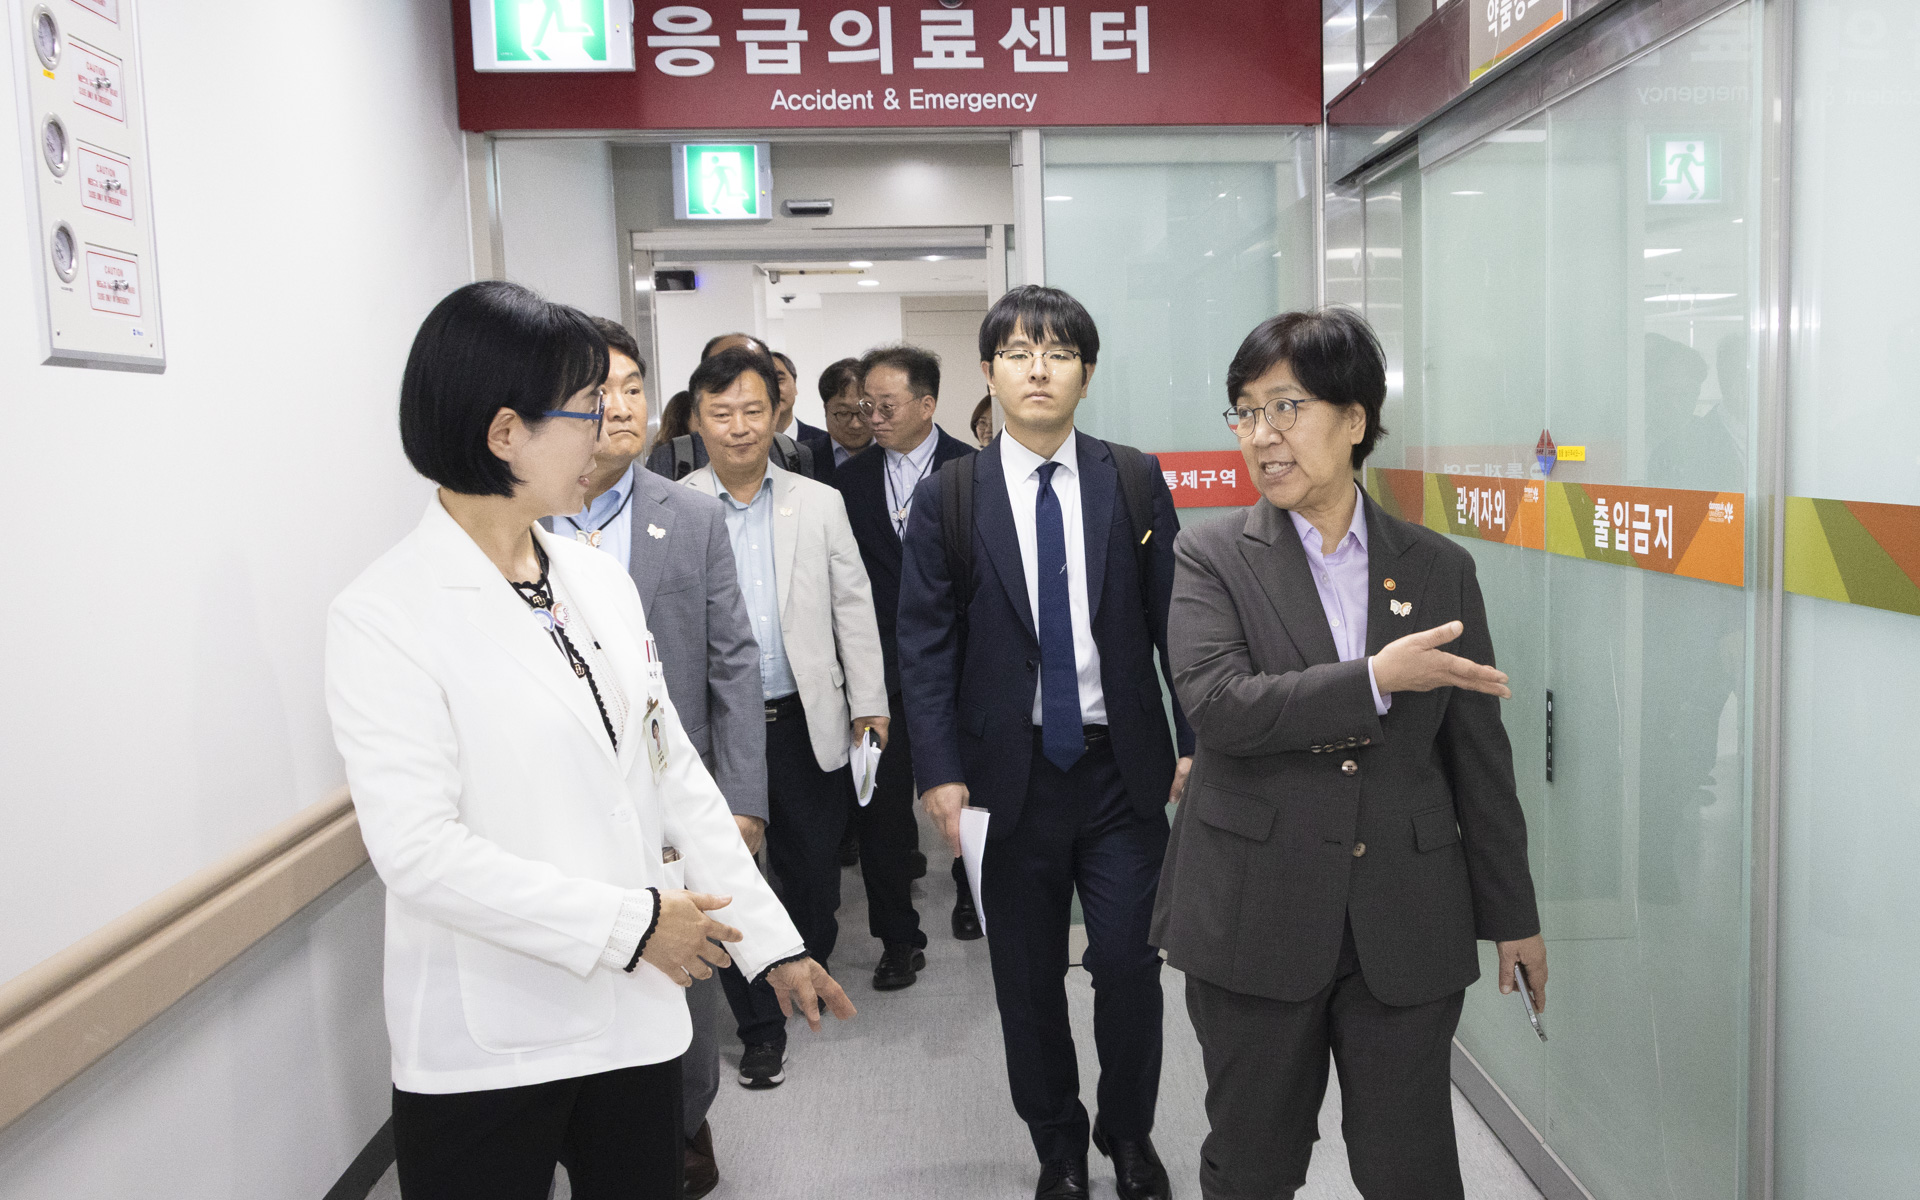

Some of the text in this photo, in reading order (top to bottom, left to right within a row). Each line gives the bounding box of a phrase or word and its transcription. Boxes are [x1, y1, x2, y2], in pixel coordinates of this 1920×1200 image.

[647, 6, 1150, 77] 응급의료센터
[770, 88, 1038, 113] Accident & Emergency
[1162, 468, 1237, 490] 통제구역
[1456, 486, 1506, 532] 관계자외
[1593, 498, 1673, 559] 출입금지
